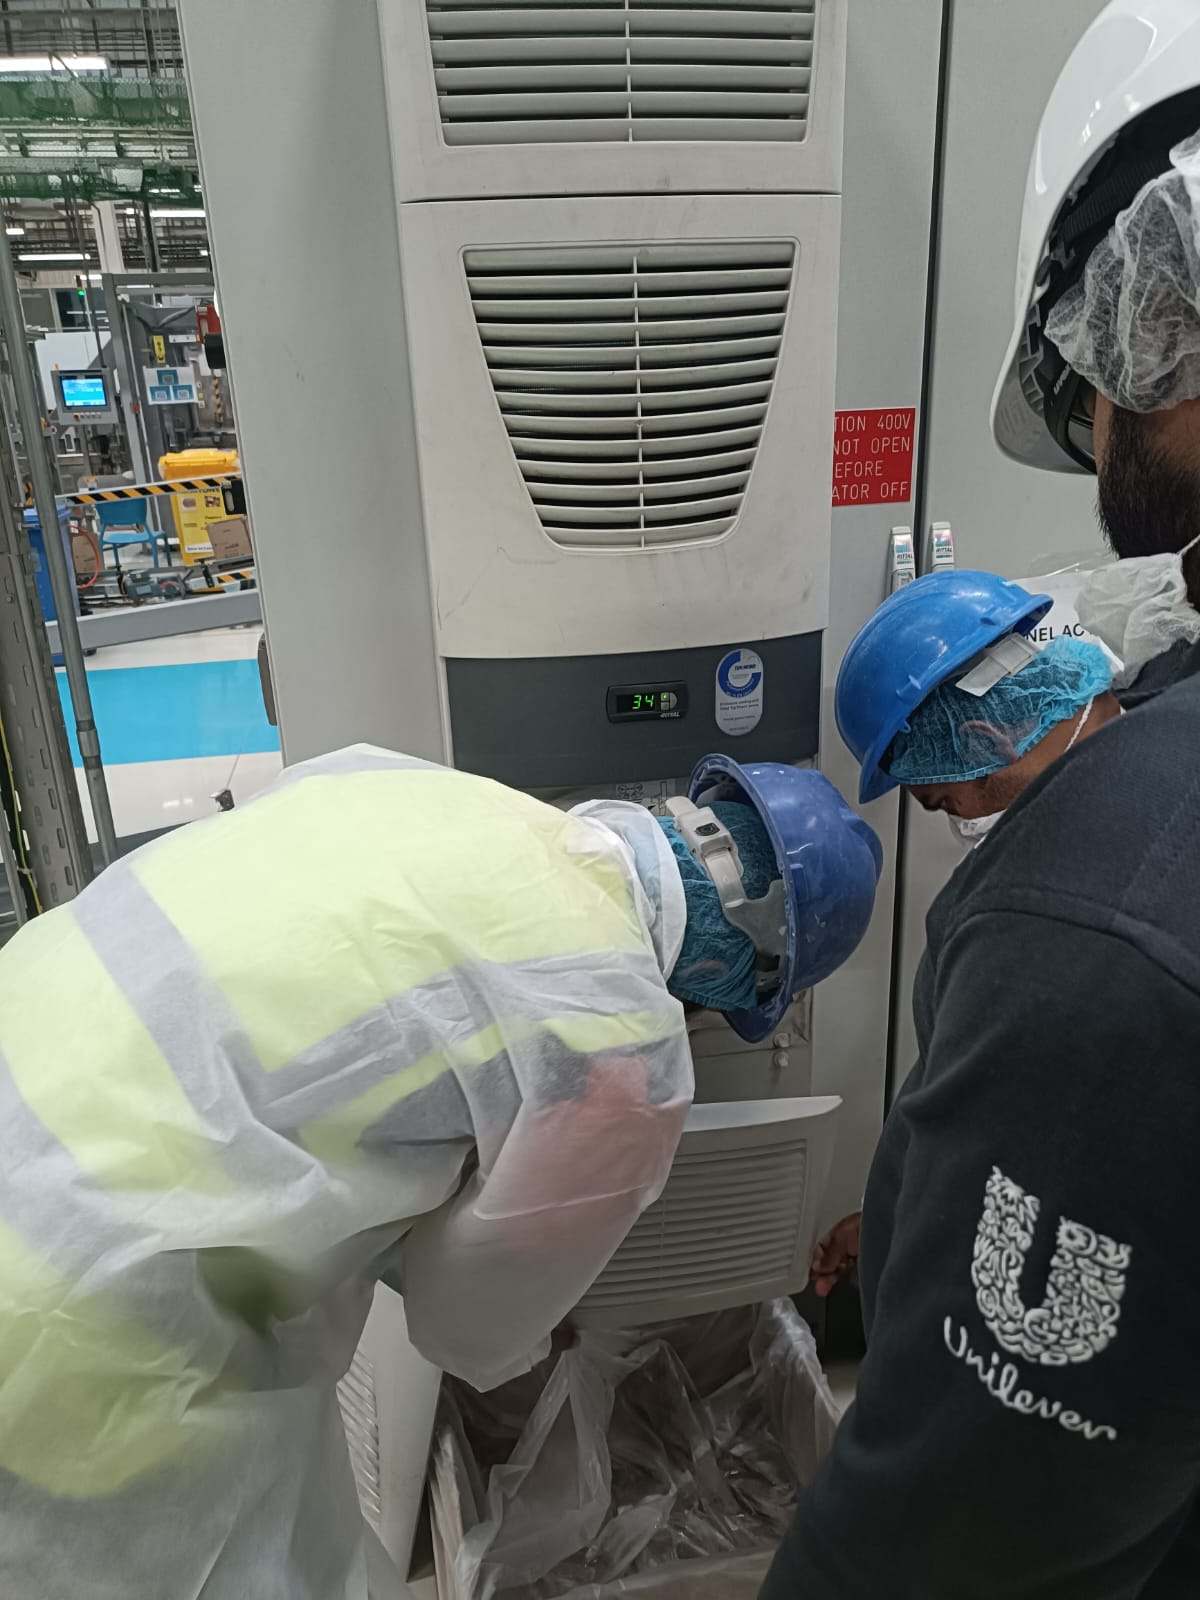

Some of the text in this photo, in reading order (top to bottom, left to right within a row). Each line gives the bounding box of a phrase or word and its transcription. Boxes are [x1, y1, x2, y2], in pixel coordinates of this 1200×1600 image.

[834, 413, 911, 432] TION 400V
[833, 436, 910, 455] NOT OPEN
[835, 460, 883, 478] EFORE
[832, 481, 908, 500] ATOR OFF
[1026, 626, 1055, 642] NEL
[632, 694, 655, 710] 34
[944, 1316, 1117, 1440] Unilever
